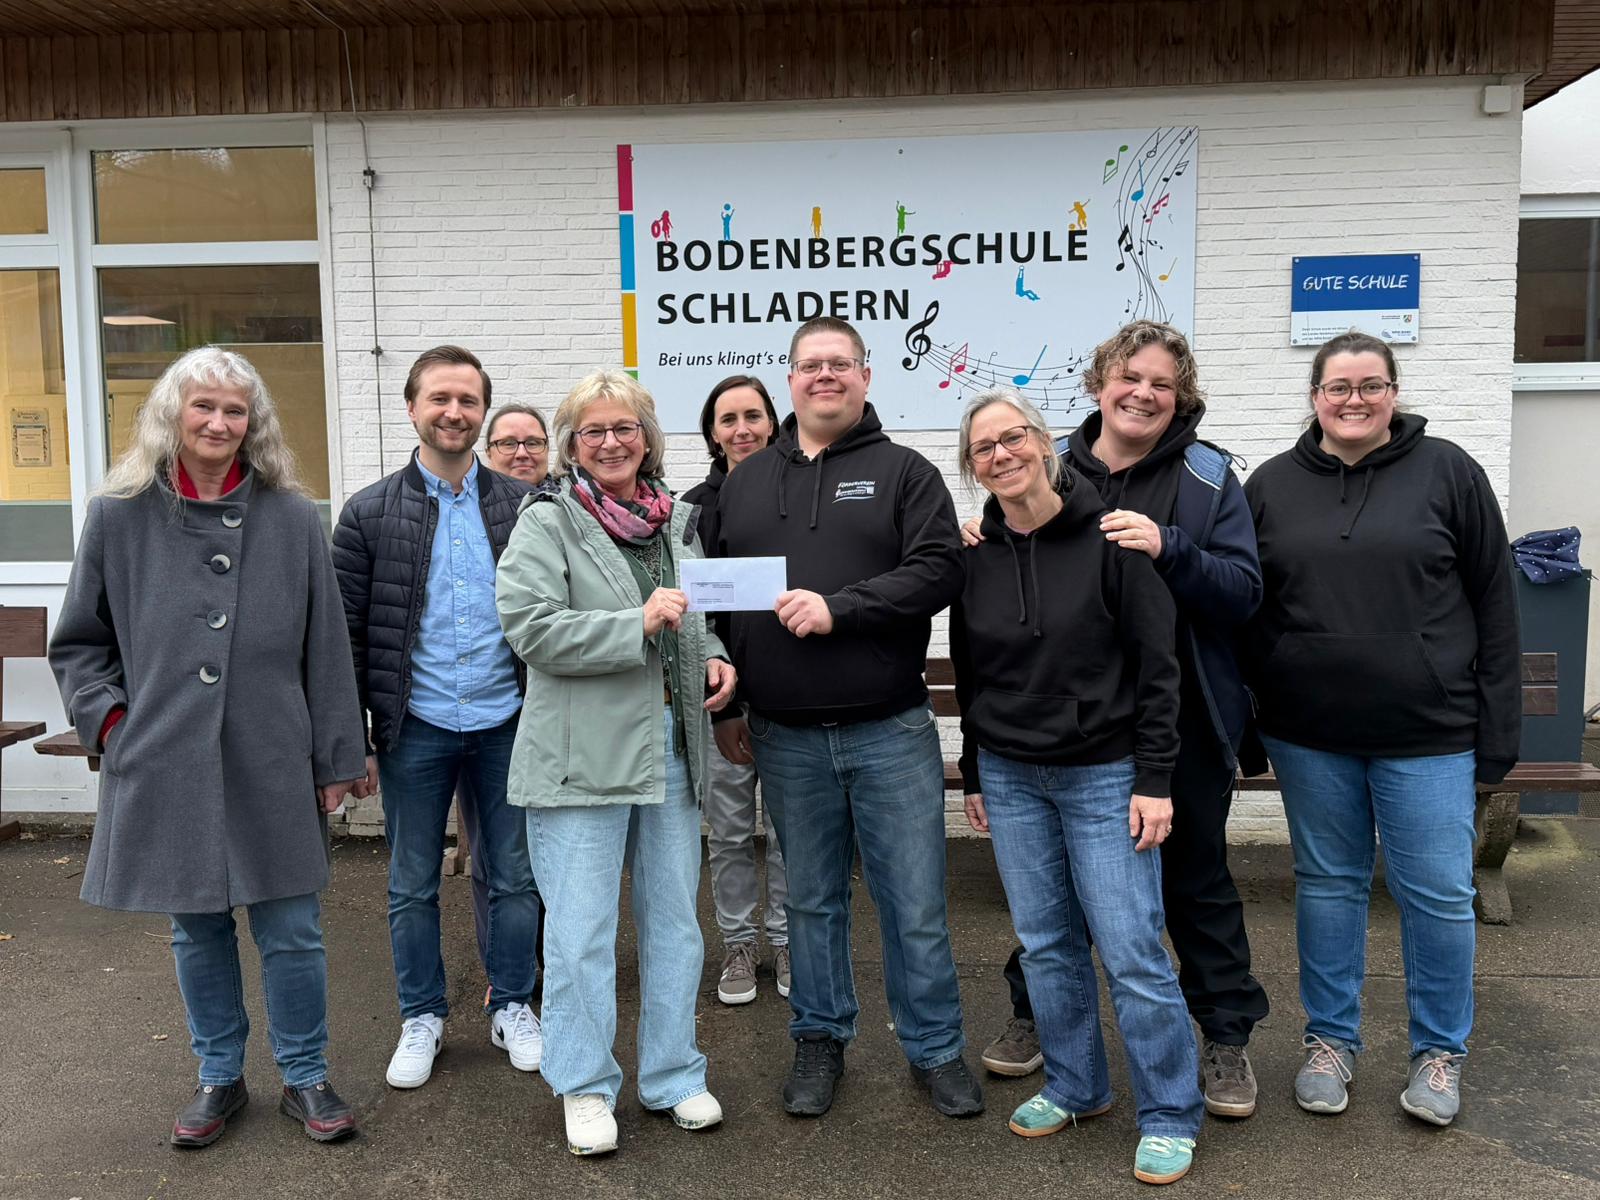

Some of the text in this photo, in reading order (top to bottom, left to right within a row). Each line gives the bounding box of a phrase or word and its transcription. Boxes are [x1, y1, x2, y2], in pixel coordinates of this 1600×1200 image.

[656, 229, 1089, 272] BODENBERGSCHULE
[1302, 274, 1409, 291] GUTE SCHULE
[657, 288, 910, 324] SCHLADERN
[658, 352, 682, 366] Bei
[686, 355, 713, 366] uns
[717, 351, 774, 369] klingt's
